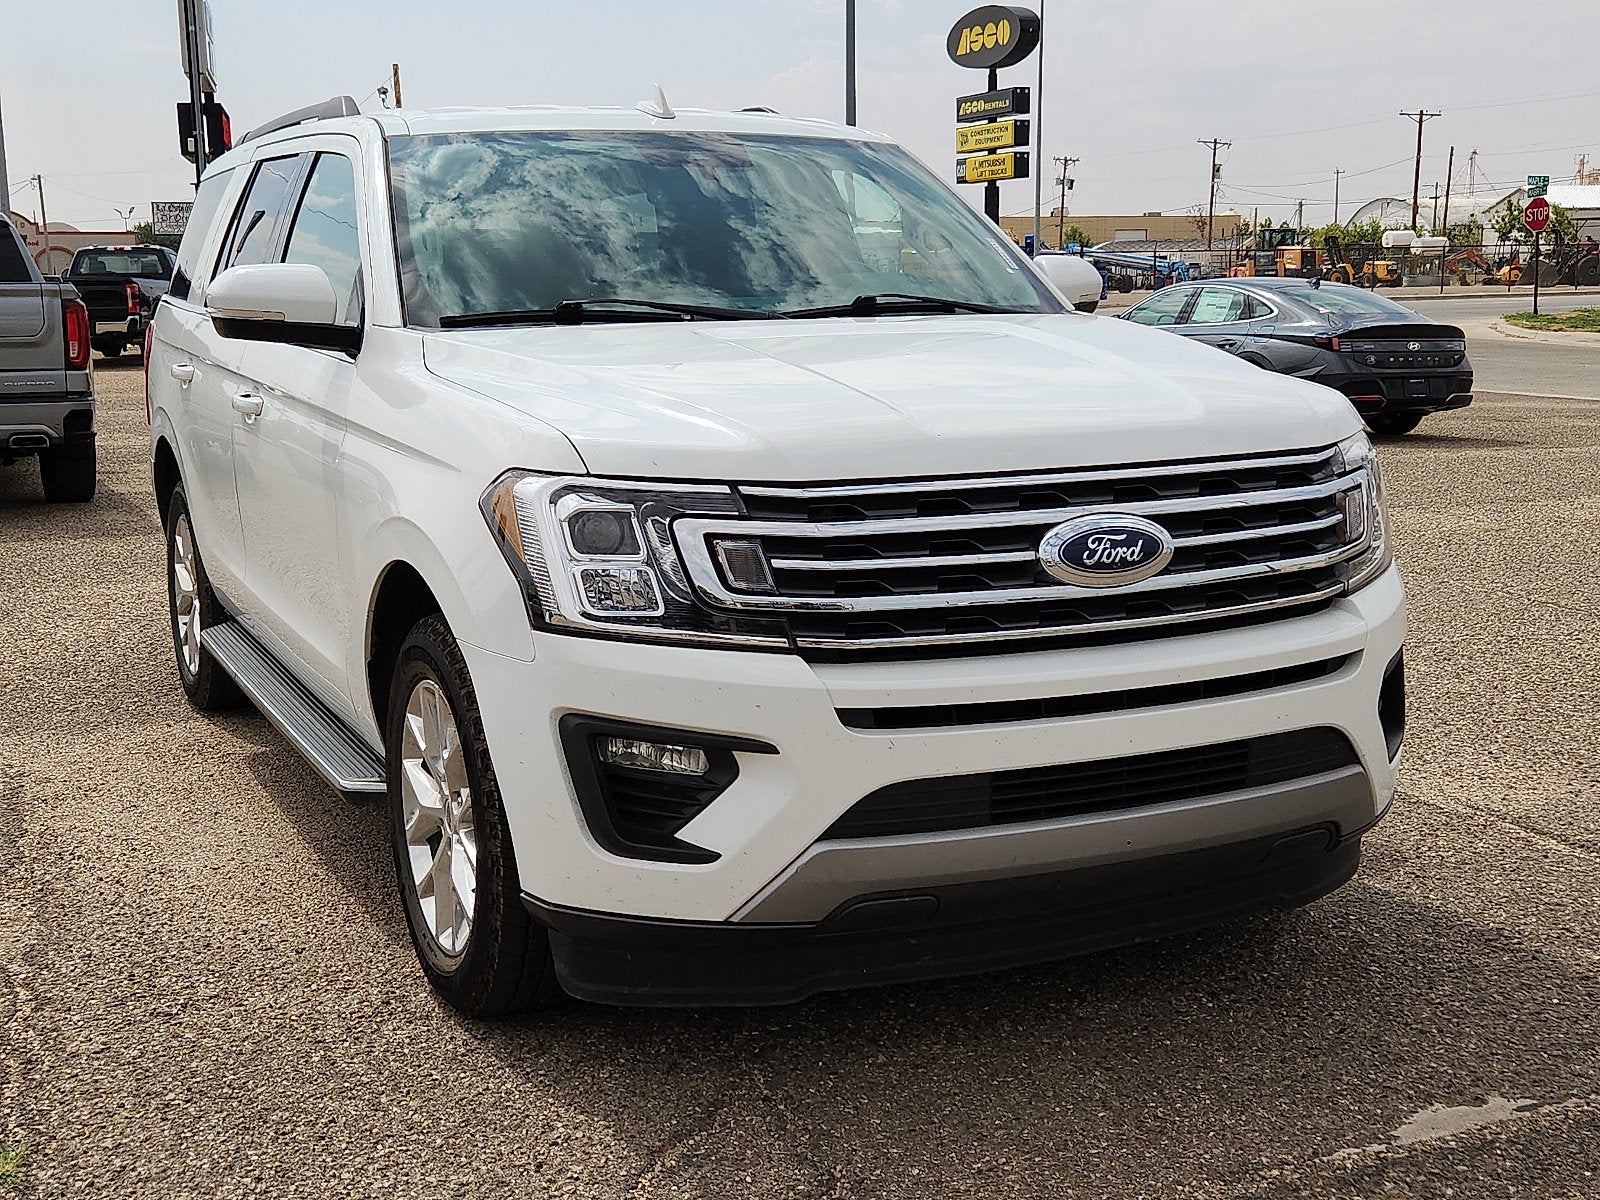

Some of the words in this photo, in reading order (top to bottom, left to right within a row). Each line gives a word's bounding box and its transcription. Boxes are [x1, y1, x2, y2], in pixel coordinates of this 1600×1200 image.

[956, 19, 1011, 56] ASCO
[959, 100, 984, 115] ASCO
[984, 99, 1010, 110] RENTALS
[970, 125, 1009, 138] CONSTRUCTION
[974, 135, 1004, 146] EQUIPMENT
[977, 157, 1006, 169] MITSUBISHI
[977, 170, 987, 178] LIFT
[987, 167, 1008, 177] TRUCKS
[1528, 176, 1544, 185] MAPLE
[1526, 207, 1549, 222] STOP
[1083, 533, 1144, 566] Ford
